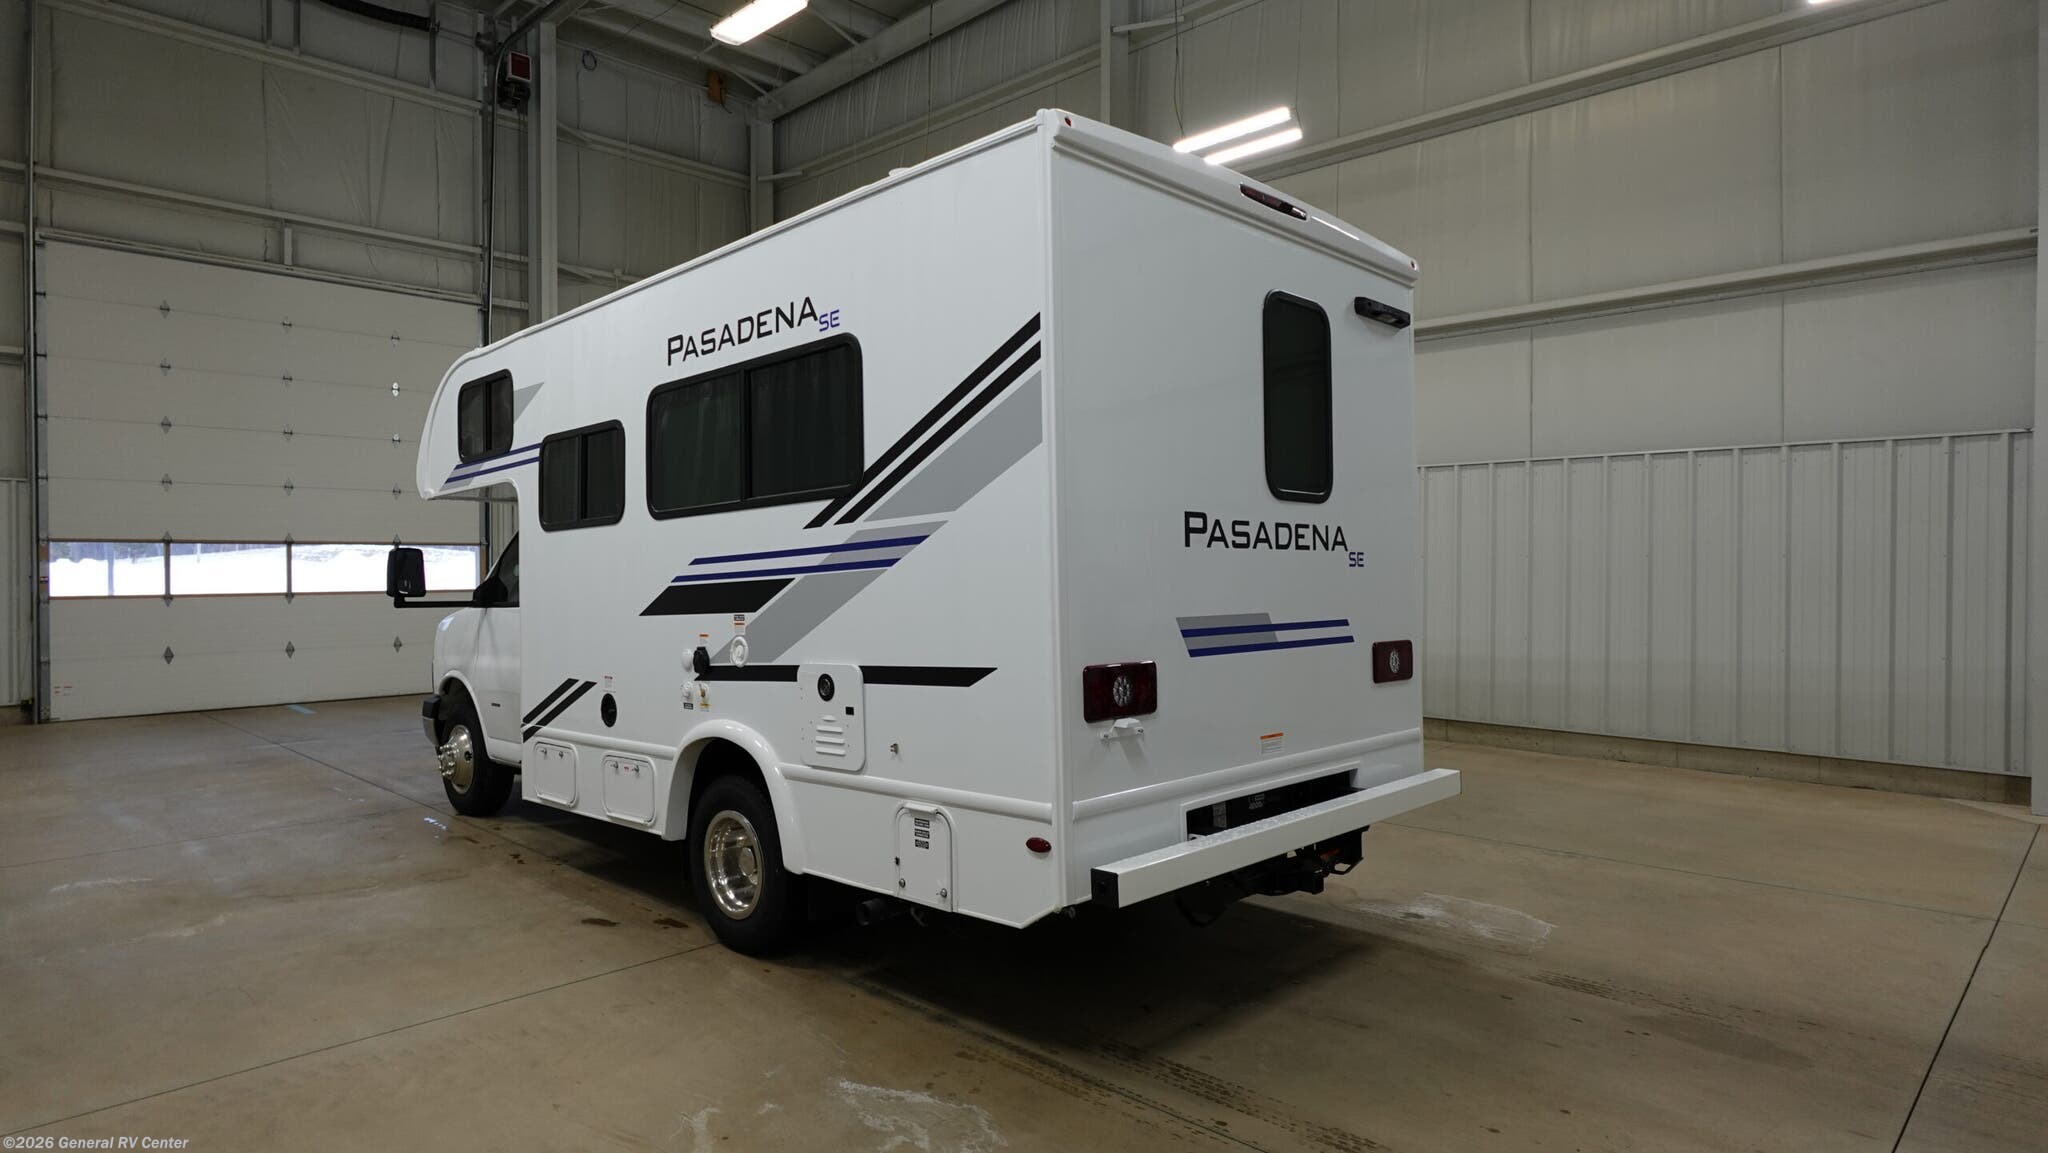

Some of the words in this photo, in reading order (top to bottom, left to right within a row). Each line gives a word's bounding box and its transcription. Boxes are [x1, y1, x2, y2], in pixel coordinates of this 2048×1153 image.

[667, 296, 819, 367] PASADENA
[818, 309, 841, 332] SE
[1184, 510, 1349, 552] PASADENA
[1348, 551, 1365, 568] SE
